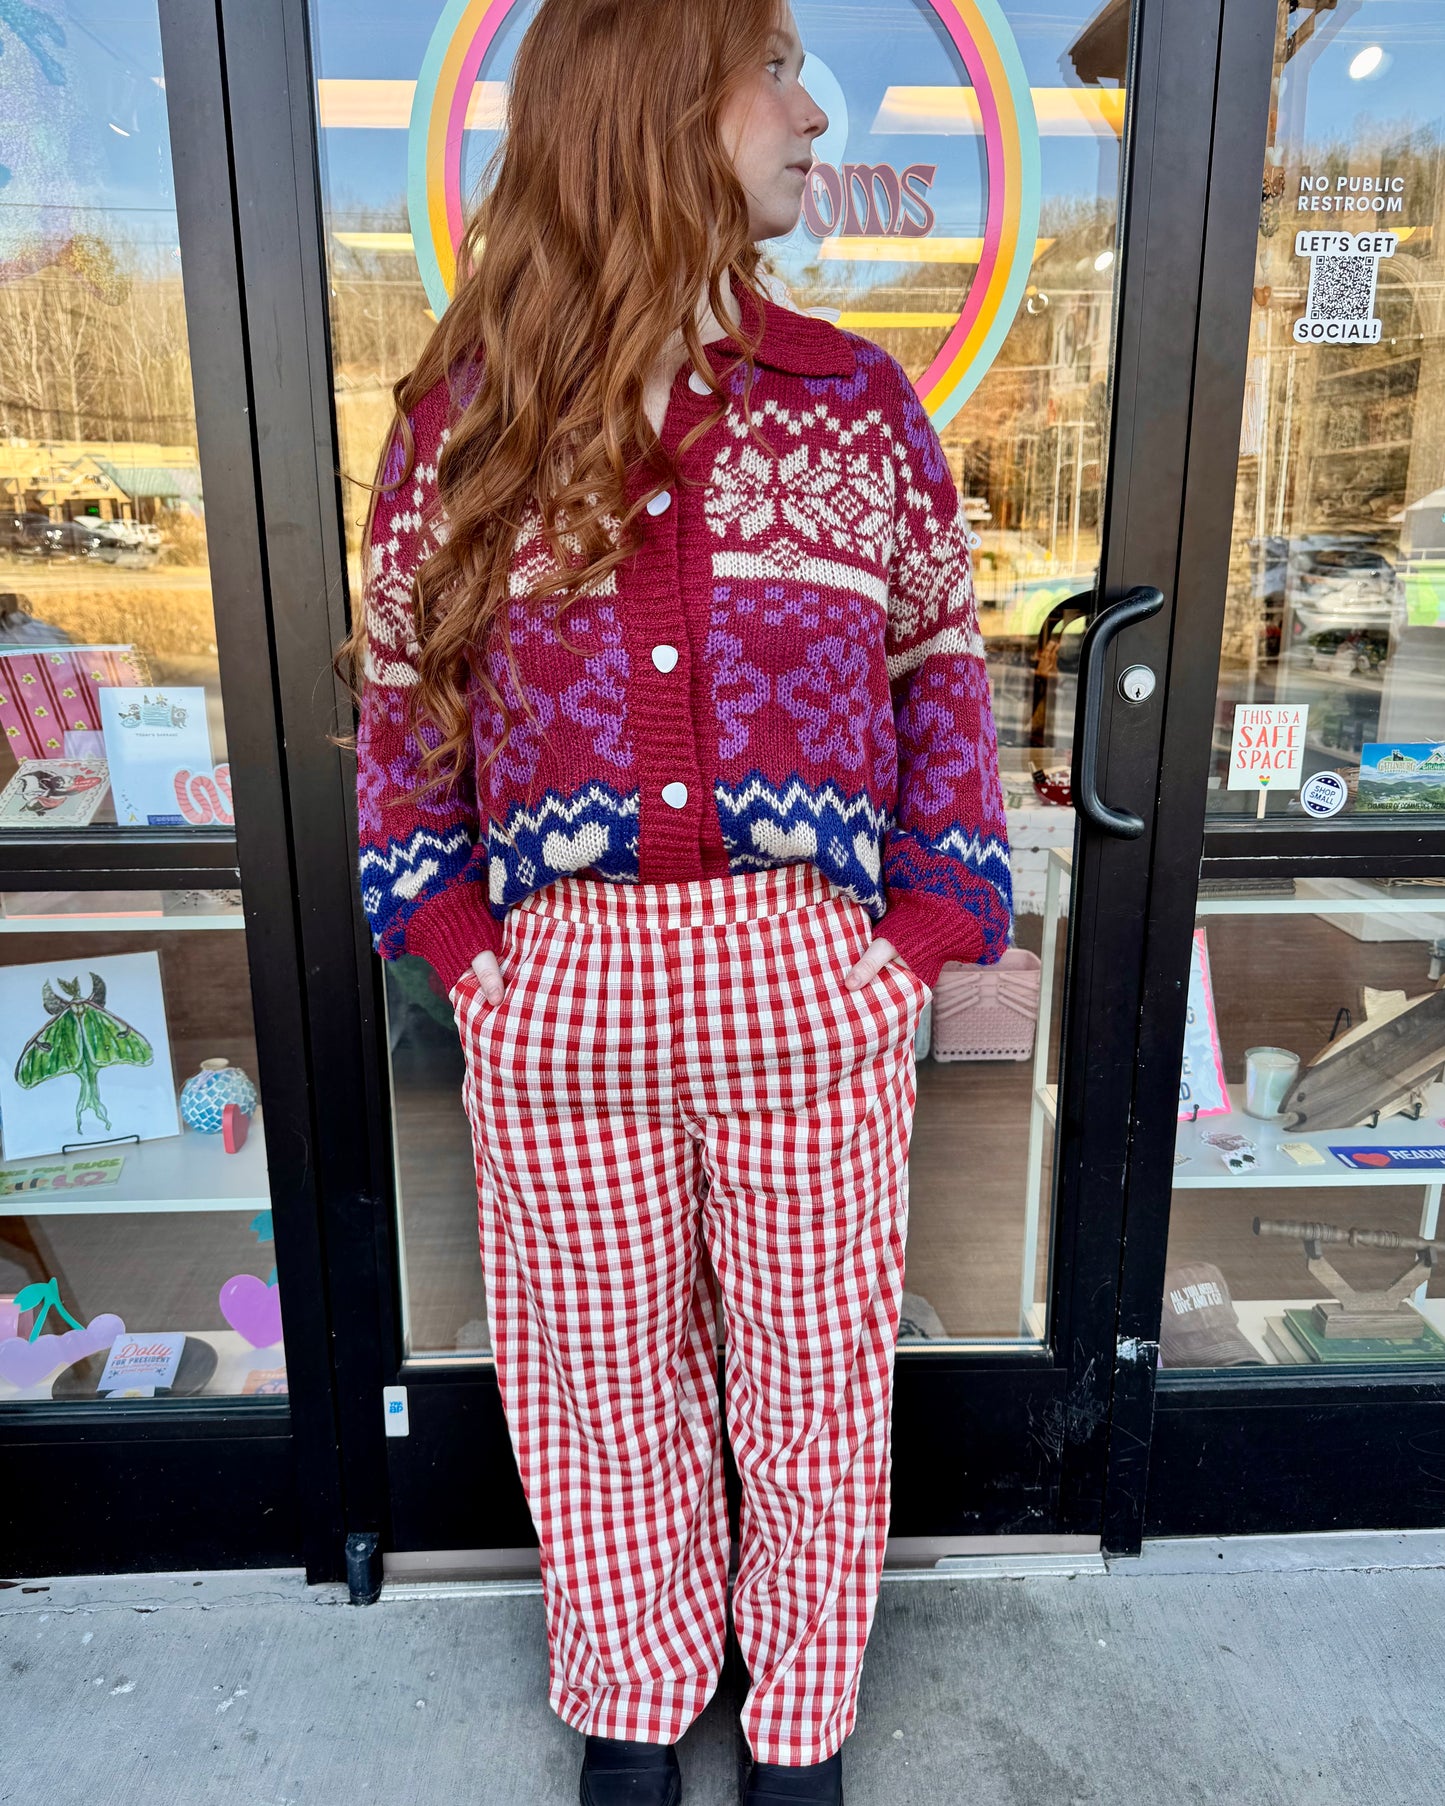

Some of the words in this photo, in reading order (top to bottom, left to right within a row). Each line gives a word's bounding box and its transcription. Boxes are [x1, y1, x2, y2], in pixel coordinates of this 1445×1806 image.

[1300, 176, 1329, 192] NO
[1337, 176, 1405, 193] PUBLIC
[1298, 196, 1403, 212] RESTROOM
[1300, 236, 1350, 252] LET'S
[1358, 237, 1394, 252] GET
[1298, 323, 1377, 339] SOCIAL!
[1241, 709, 1273, 725] THIS
[1277, 711, 1289, 724] IS
[1293, 711, 1300, 723] A
[1238, 726, 1300, 748] SAFE
[1236, 749, 1298, 770] SPACE
[1309, 791, 1334, 805] SMALL
[1313, 785, 1336, 797] SHOP
[1337, 1153, 1358, 1168] I
[1170, 1289, 1183, 1302] ALL
[1181, 1284, 1200, 1299] YOU
[1172, 1299, 1194, 1315] LOVE
[114, 1343, 173, 1359] Dolly
[111, 1358, 127, 1367] FOR
[128, 1356, 171, 1366] PRESIDENT
